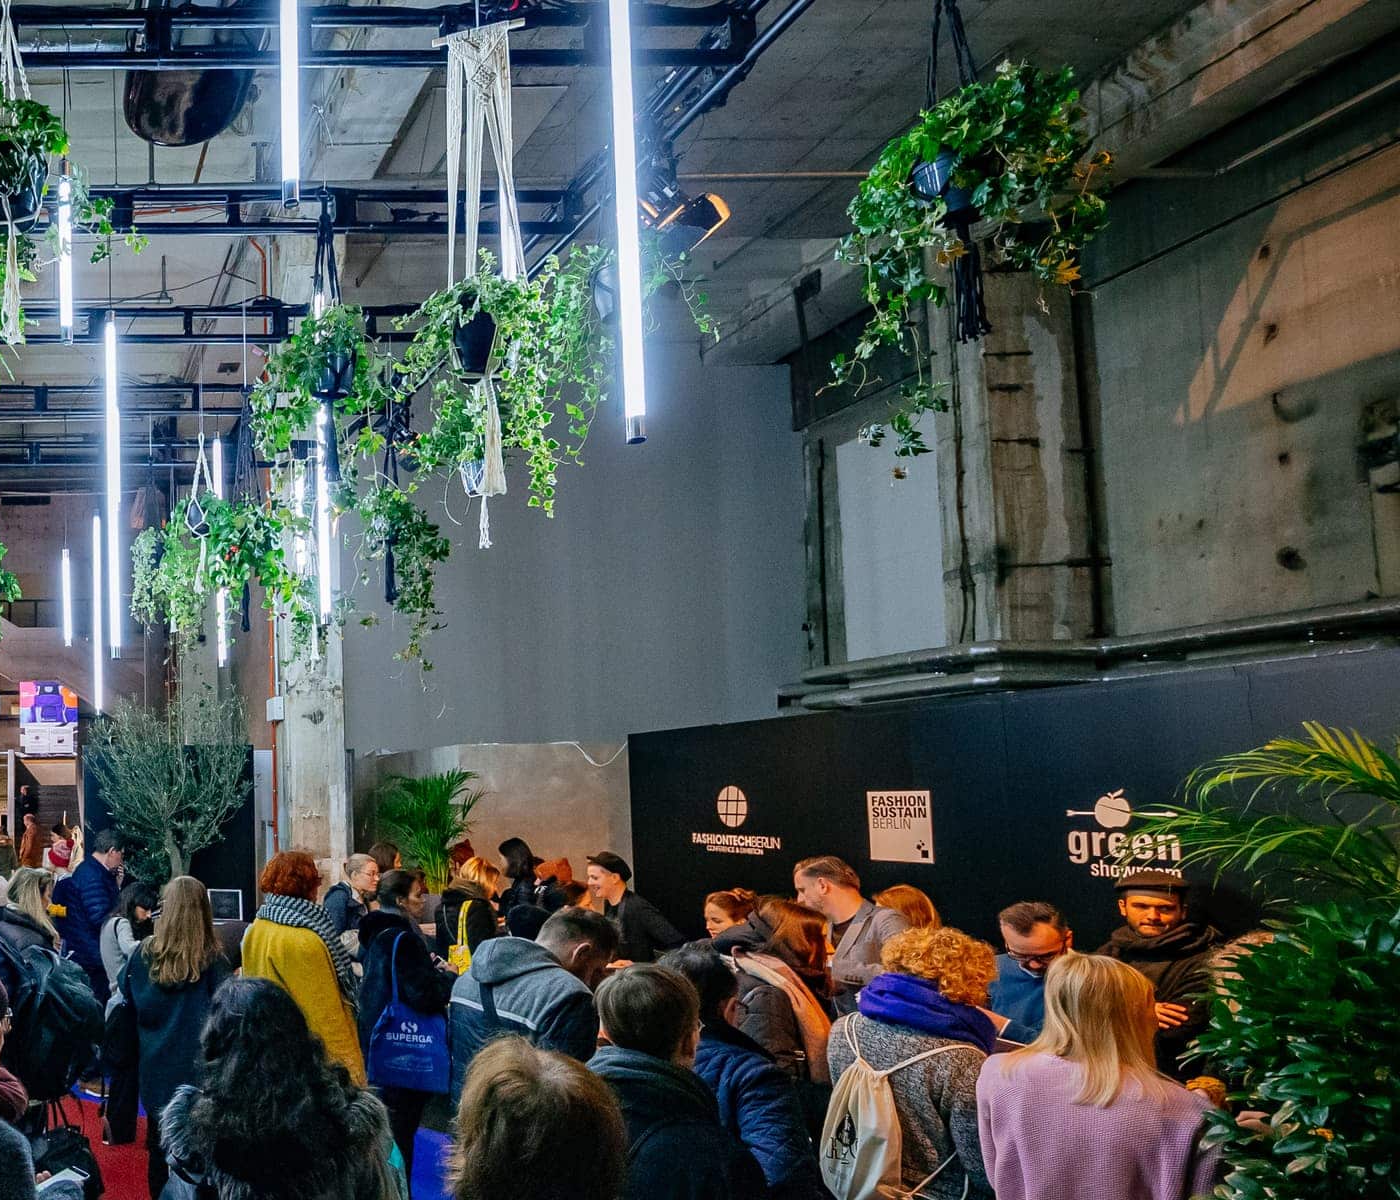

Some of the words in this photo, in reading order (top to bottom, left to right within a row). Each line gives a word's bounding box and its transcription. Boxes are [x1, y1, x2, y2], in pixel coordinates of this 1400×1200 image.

[871, 795, 926, 807] FASHION
[872, 807, 927, 818] SUSTAIN
[872, 818, 911, 830] BERLIN
[692, 832, 781, 849] FASHIONTECHBERLIN
[1067, 830, 1181, 864] green
[385, 1032, 433, 1044] SUPERGA
